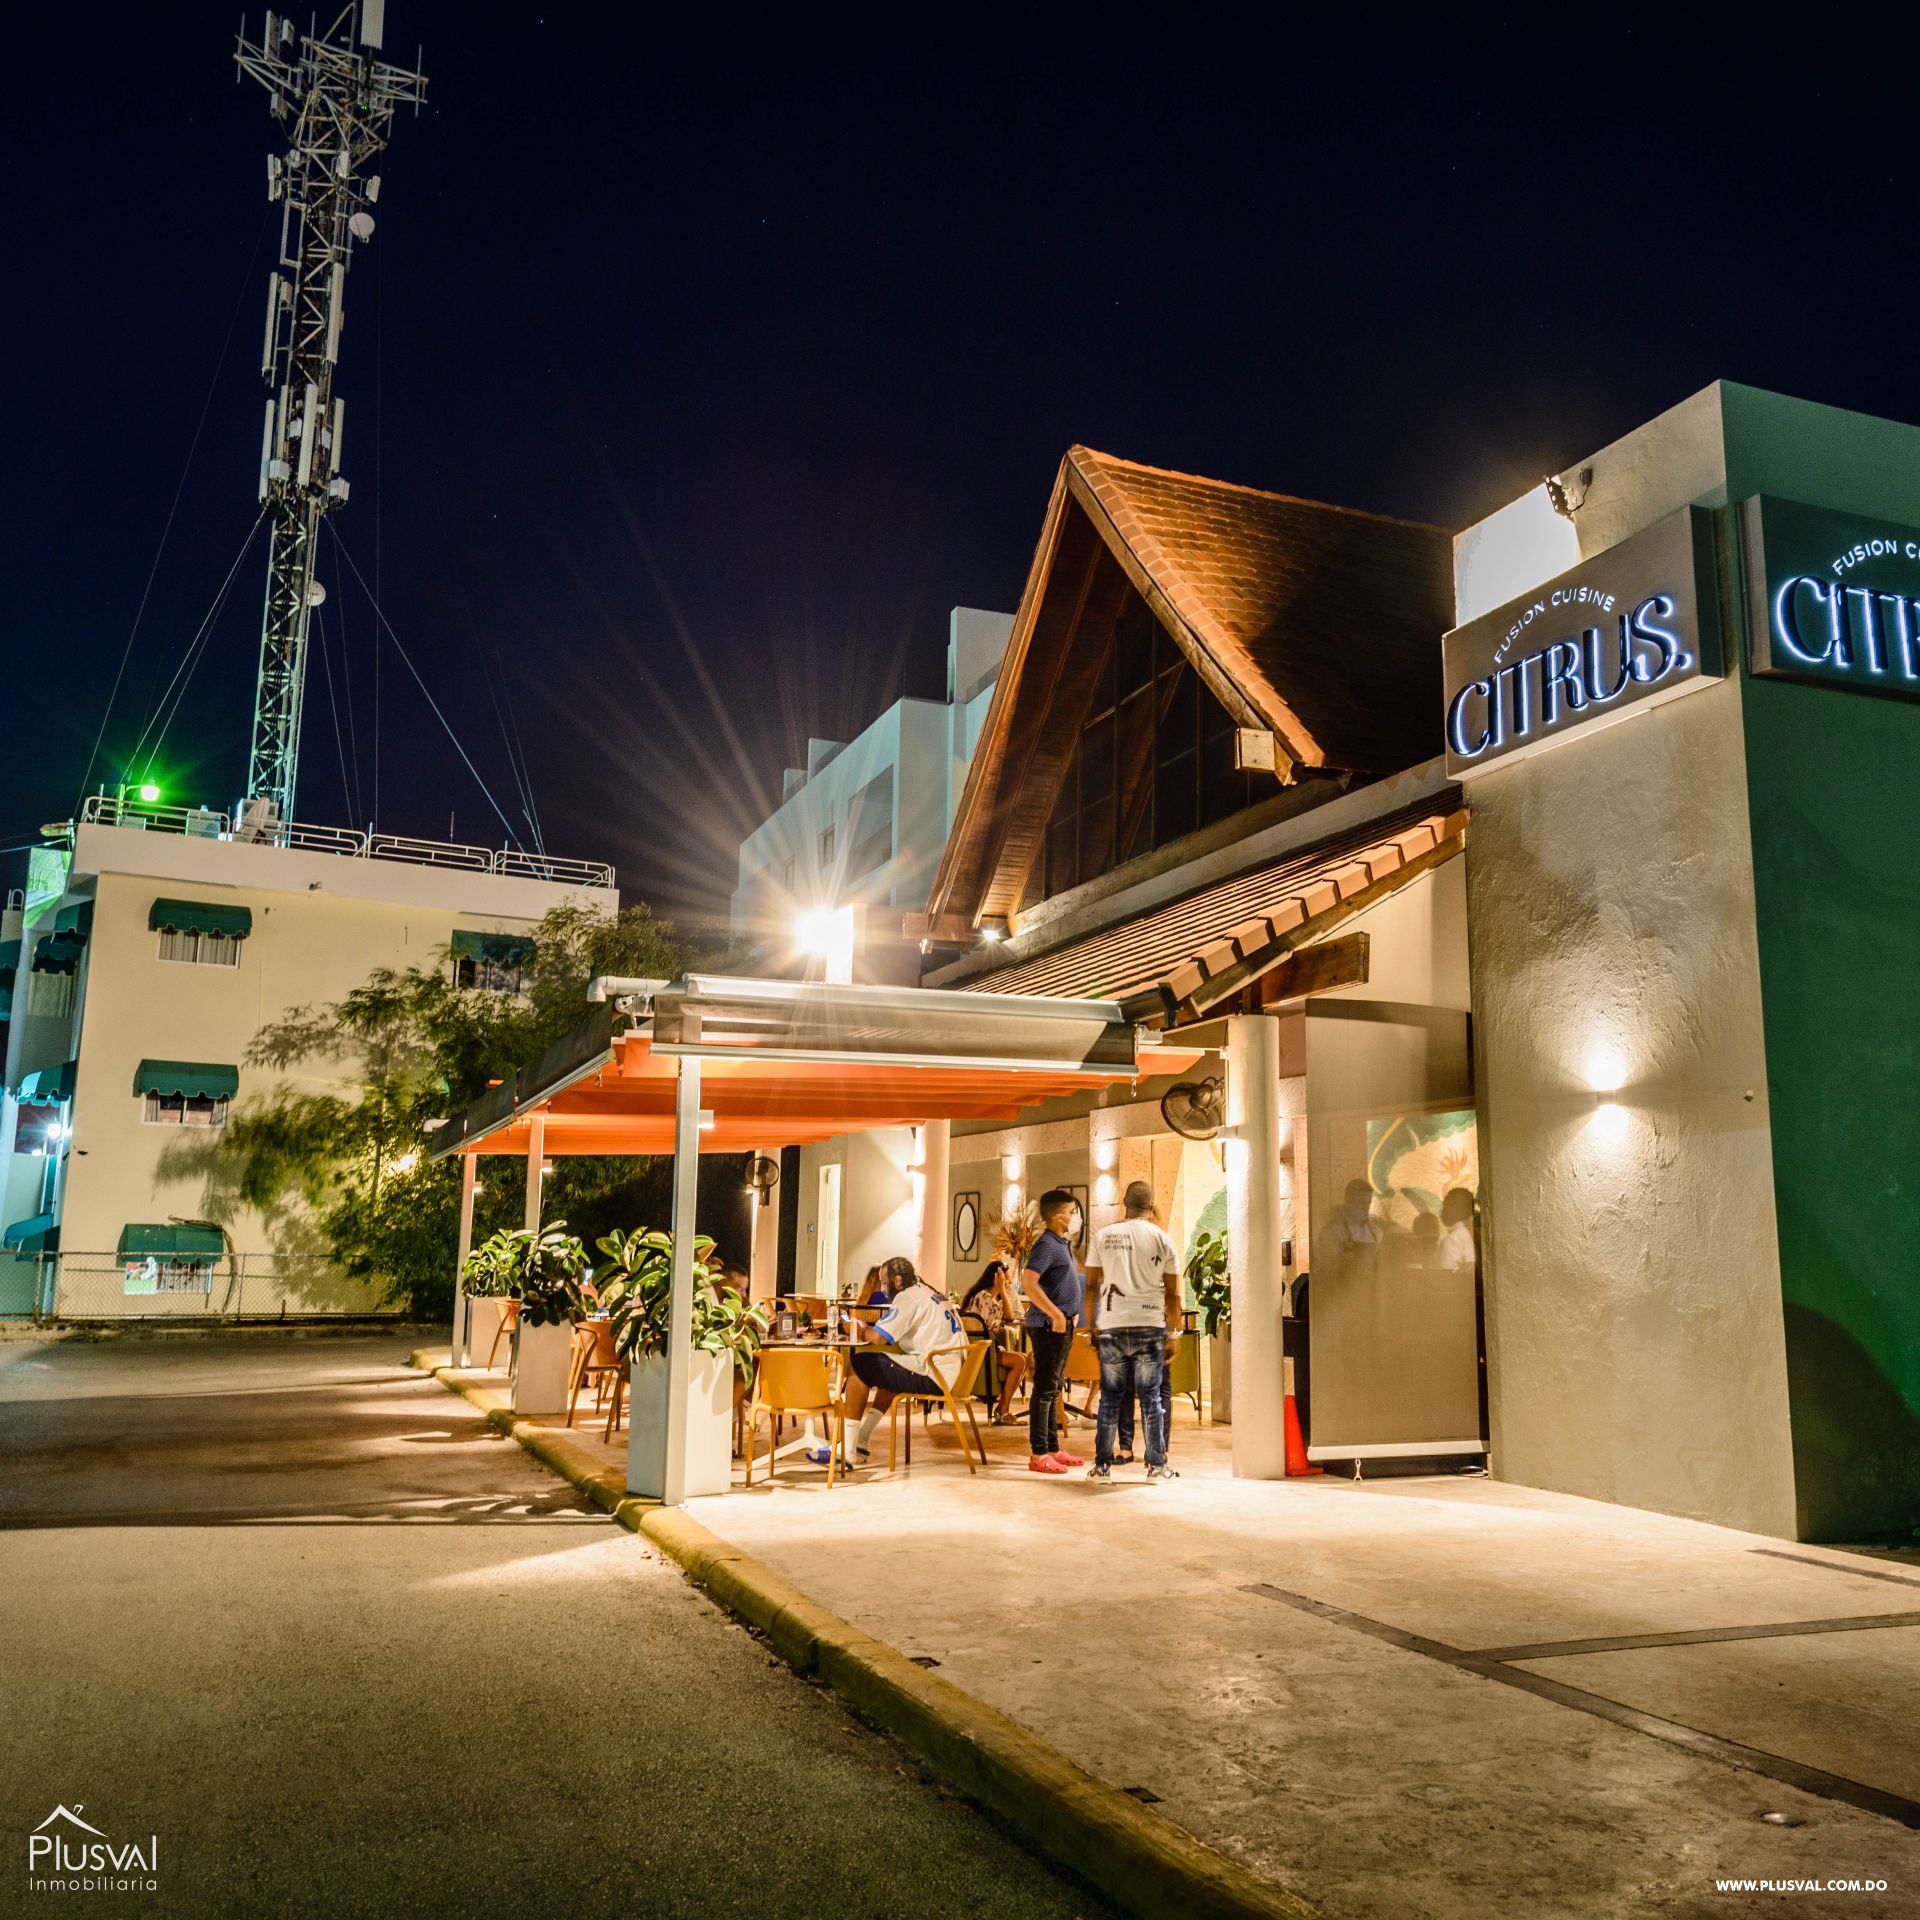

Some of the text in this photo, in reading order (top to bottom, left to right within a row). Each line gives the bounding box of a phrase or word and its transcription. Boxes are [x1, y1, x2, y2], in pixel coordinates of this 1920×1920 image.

[1831, 539, 1920, 576] FUSION C
[1494, 586, 1616, 664] FUSION CUISINE
[1447, 594, 1693, 757] CITRUS.
